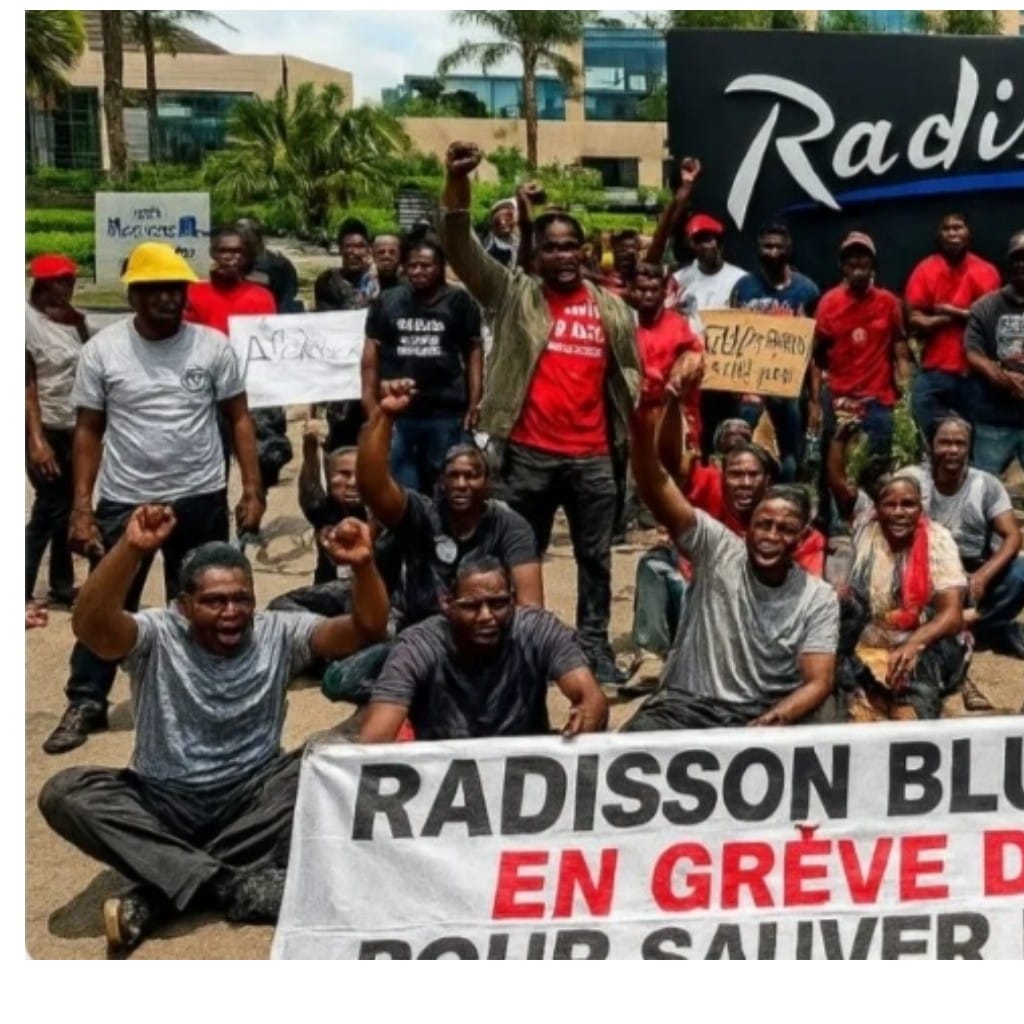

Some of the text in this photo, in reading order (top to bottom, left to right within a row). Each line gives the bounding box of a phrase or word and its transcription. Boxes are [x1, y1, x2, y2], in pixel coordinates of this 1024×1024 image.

[352, 744, 851, 841] RADISSON
[492, 848, 619, 921] EN
[651, 824, 950, 913] GRÈVE
